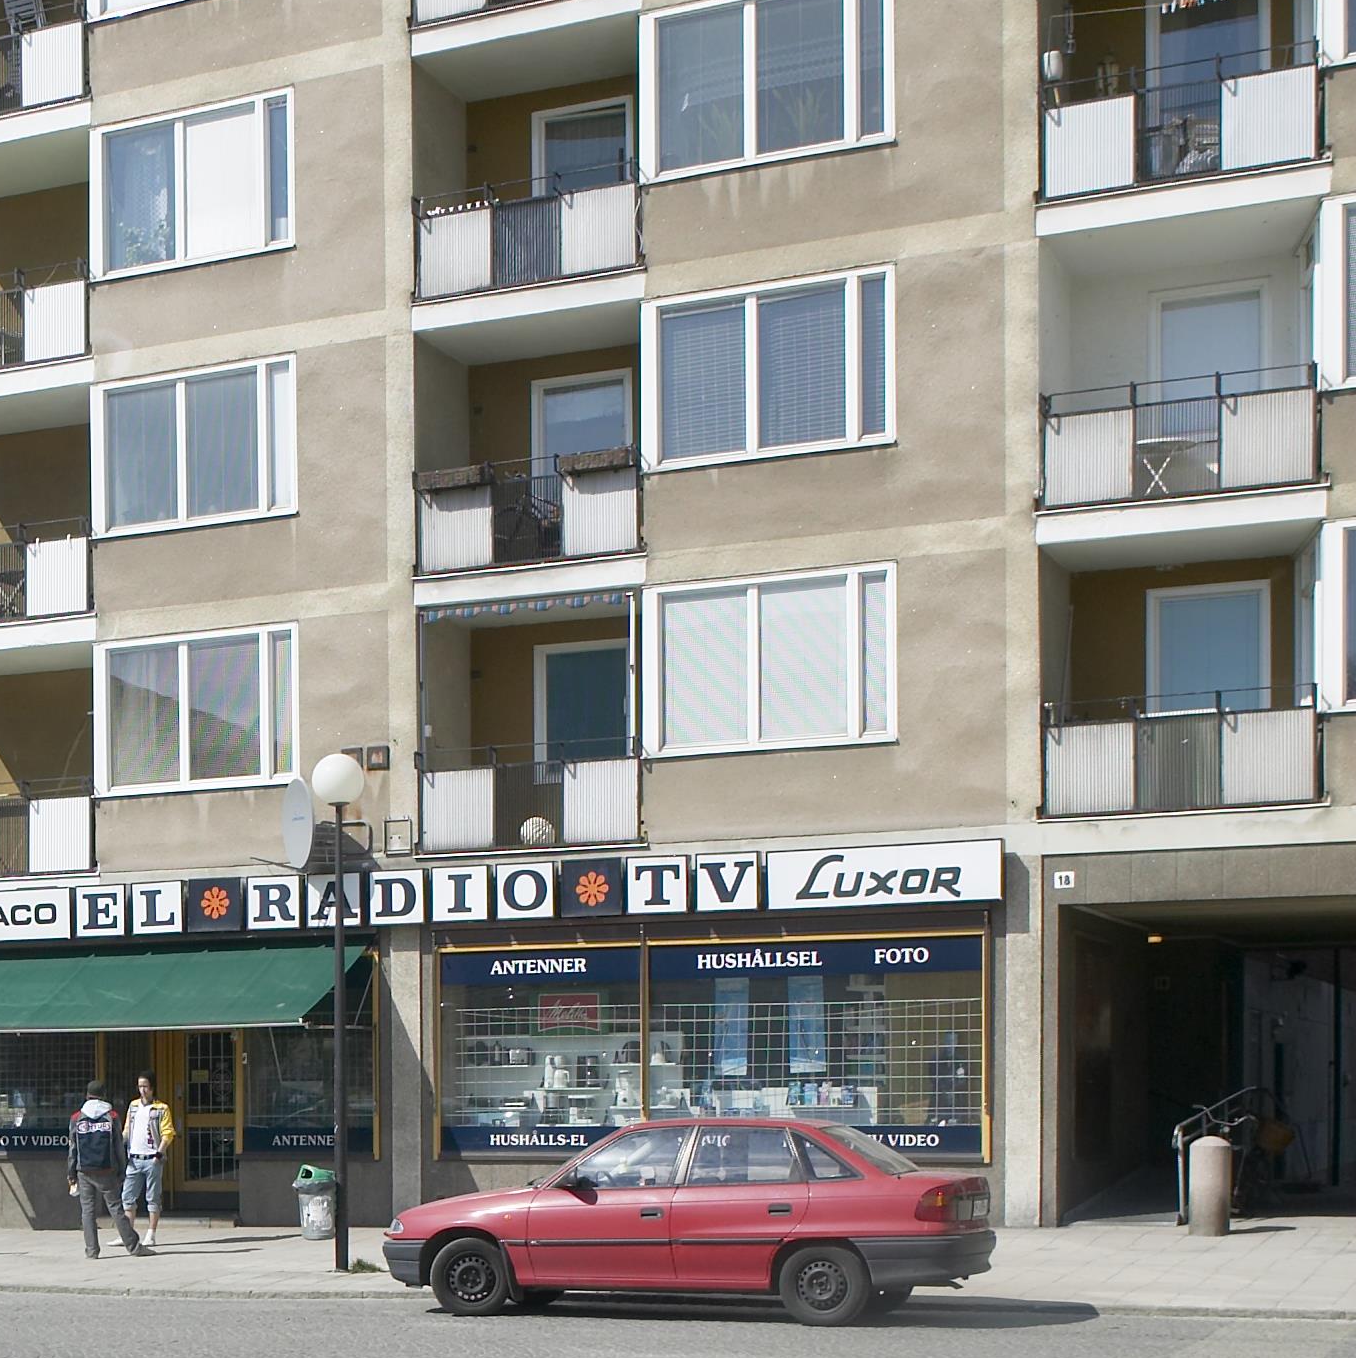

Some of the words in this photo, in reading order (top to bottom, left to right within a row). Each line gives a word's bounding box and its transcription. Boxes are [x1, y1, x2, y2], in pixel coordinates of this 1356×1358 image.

[1057, 874, 1071, 886] 18
[82, 889, 175, 930] EL
[253, 869, 548, 922] RADIO
[635, 861, 754, 906] TV
[697, 948, 823, 970] HUSHÅLLSEL
[874, 947, 930, 964] FOTO
[490, 957, 587, 976] ANTENNER
[12, 1135, 28, 1147] TV
[31, 1135, 70, 1147] VIDEO
[272, 1135, 335, 1147] ANTENNE
[489, 1130, 588, 1146] HUSHÅLLS-EL
[887, 1134, 940, 1147] VIDEO
